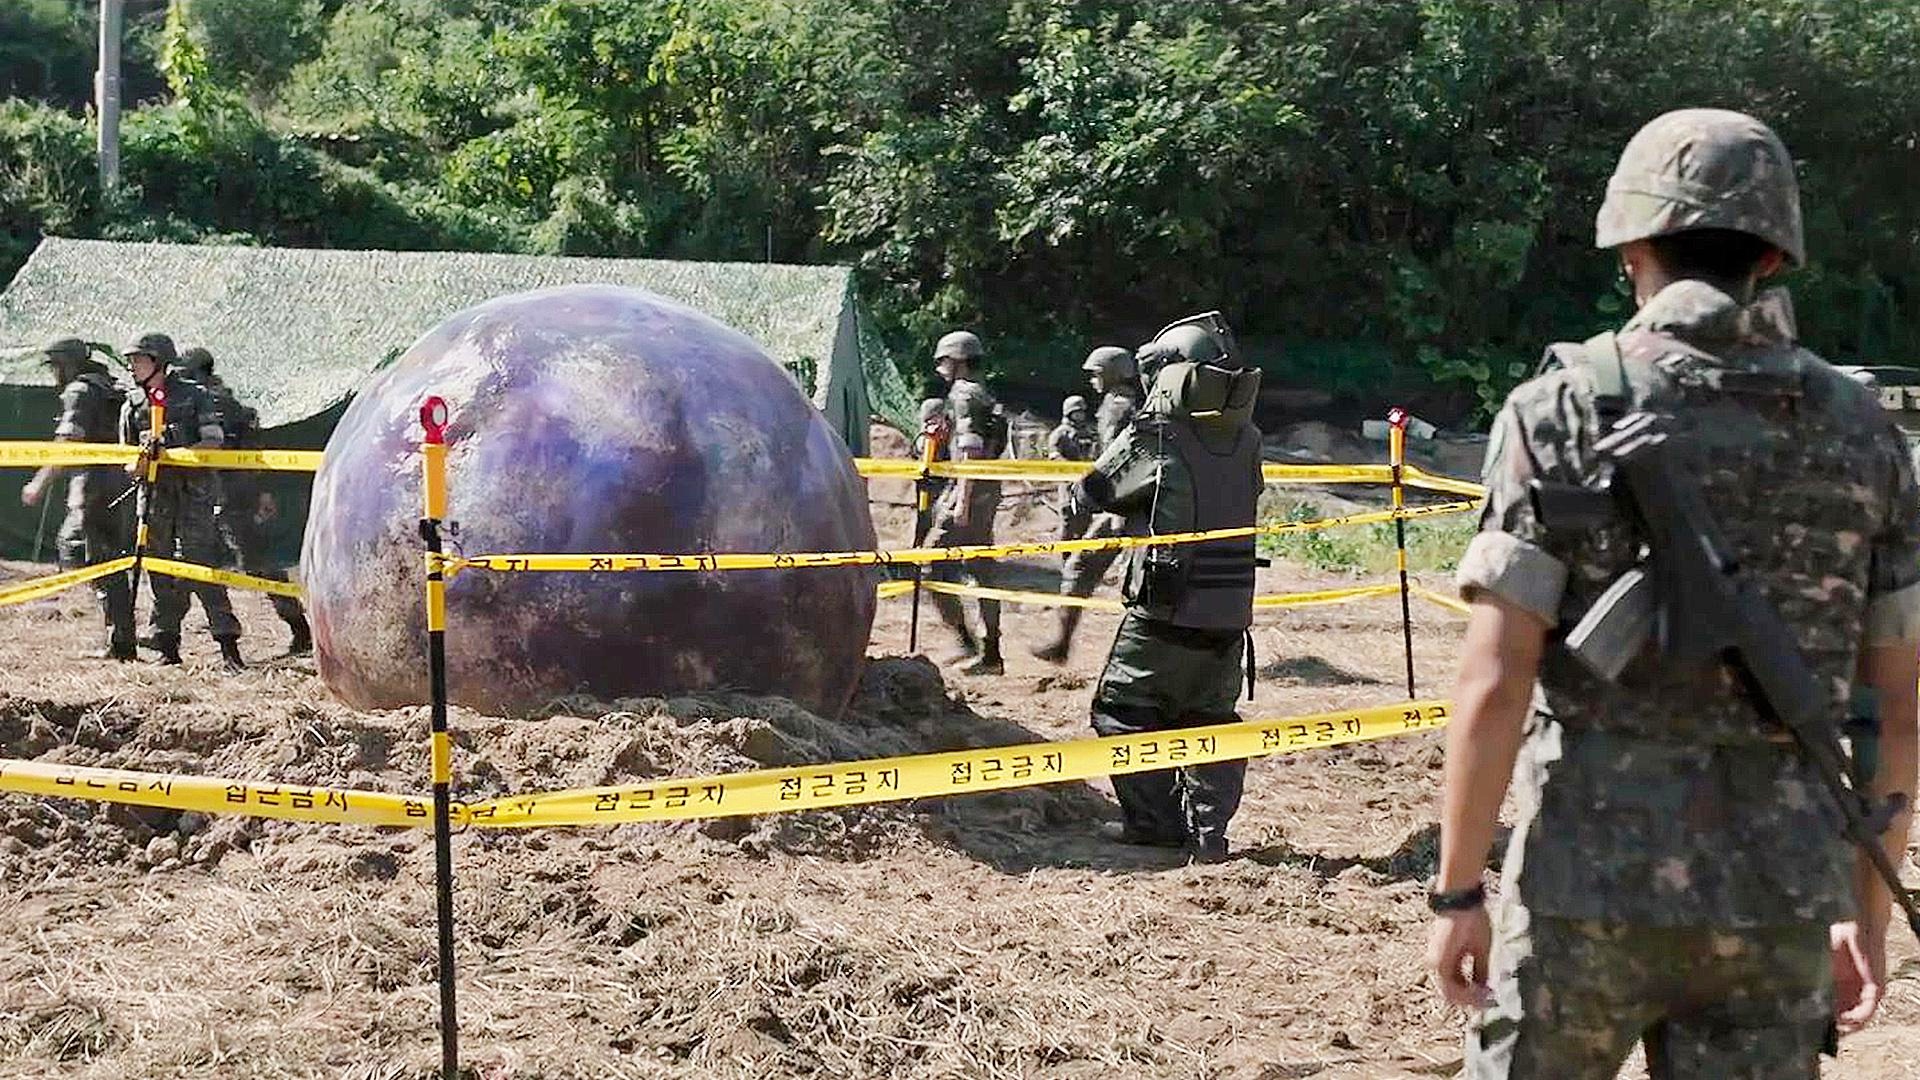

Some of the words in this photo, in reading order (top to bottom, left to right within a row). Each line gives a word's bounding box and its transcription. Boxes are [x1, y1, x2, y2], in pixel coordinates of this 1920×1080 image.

[594, 783, 724, 811] 접근금지
[780, 768, 899, 800] 접근금지
[951, 752, 1062, 784] 접근금지
[1111, 735, 1216, 767] 접근금지
[1261, 717, 1361, 749] 접근금지
